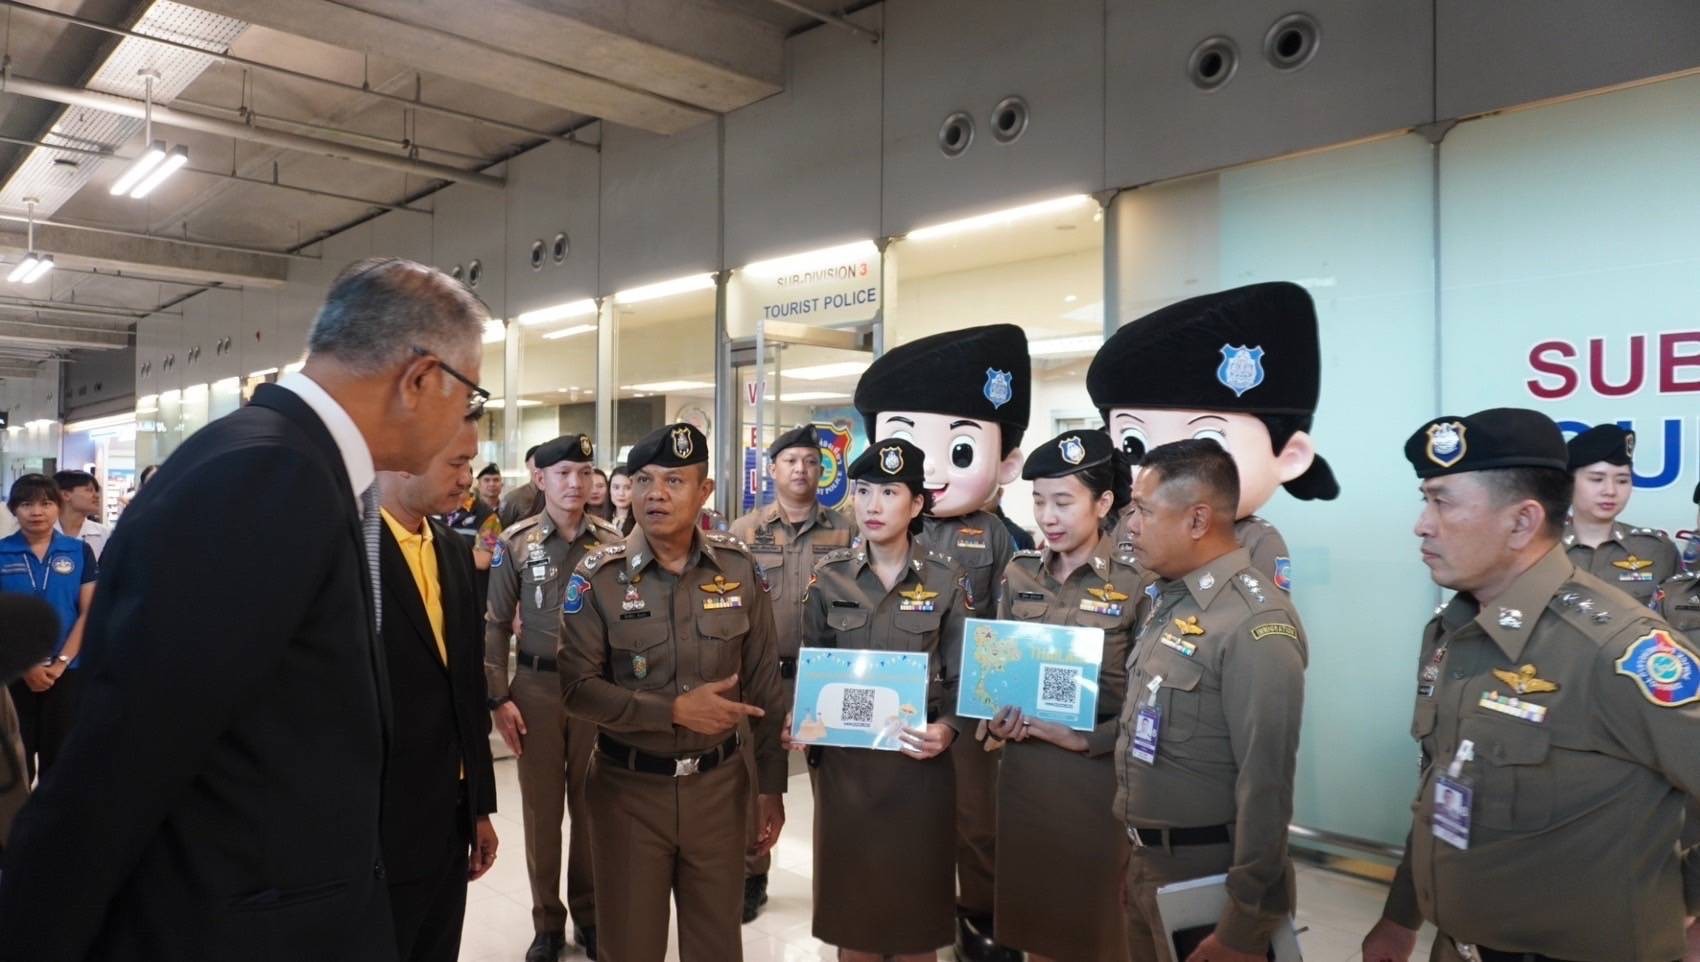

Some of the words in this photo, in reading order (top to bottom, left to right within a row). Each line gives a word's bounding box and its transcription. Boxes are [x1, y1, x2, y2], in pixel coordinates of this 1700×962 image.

[859, 263, 868, 277] 3
[764, 298, 820, 319] TOURIST
[824, 287, 876, 310] POLICE
